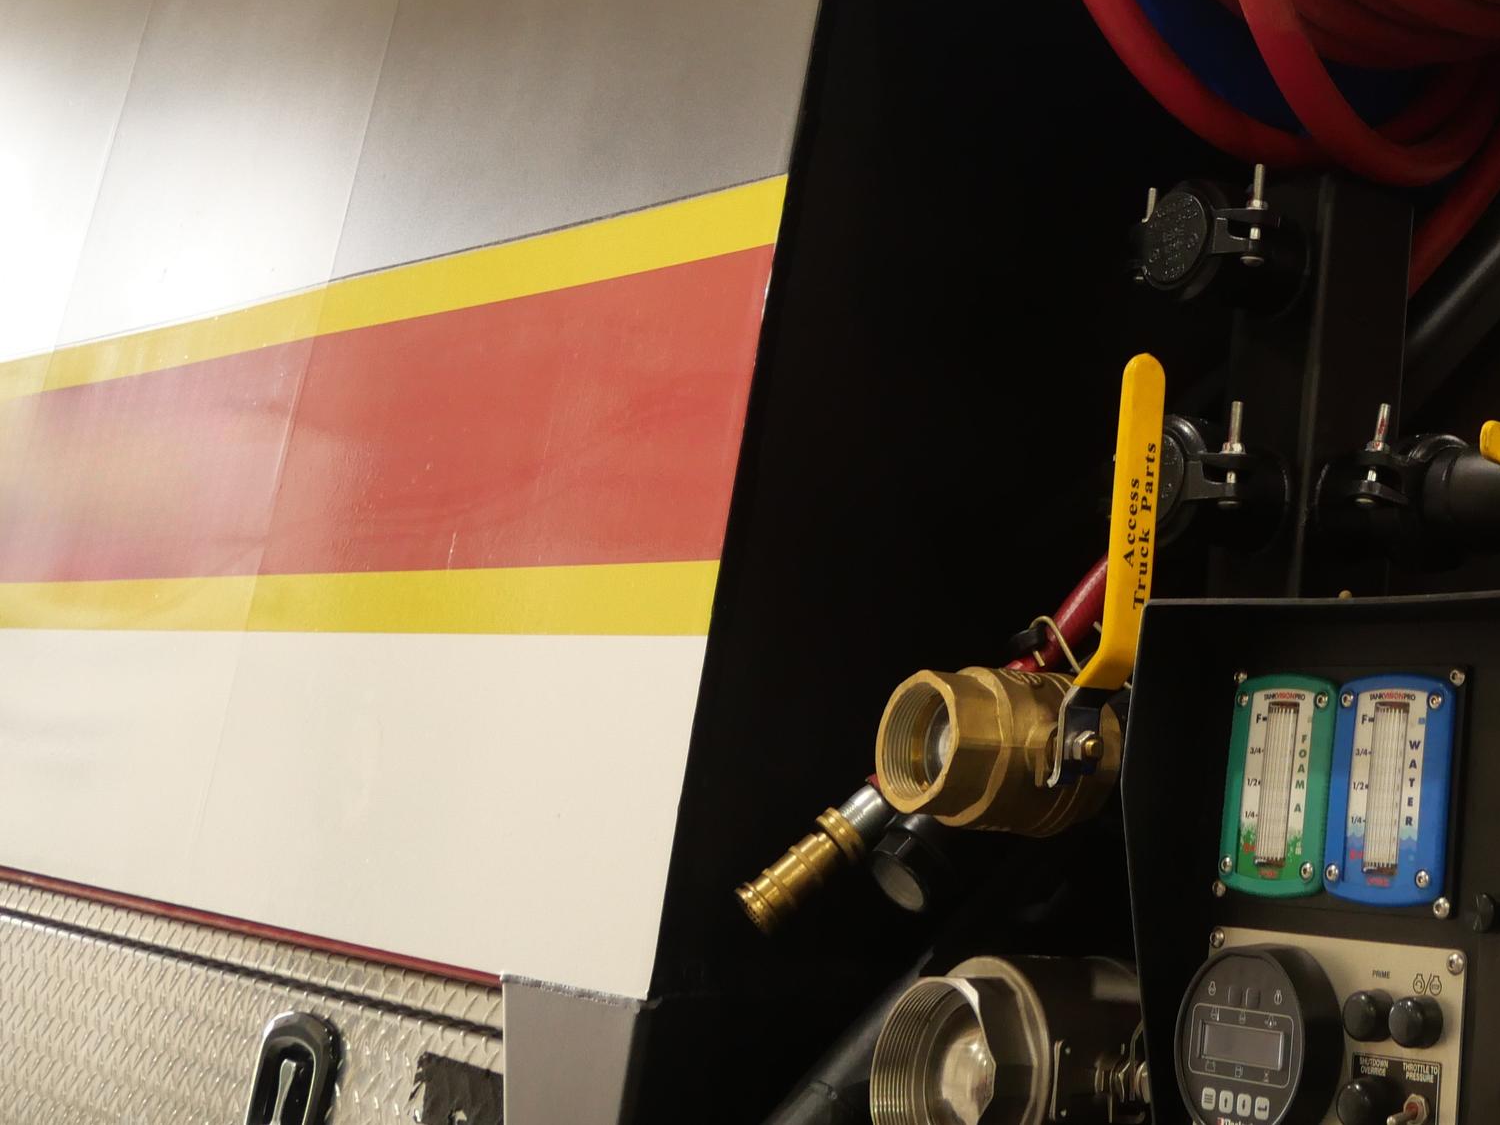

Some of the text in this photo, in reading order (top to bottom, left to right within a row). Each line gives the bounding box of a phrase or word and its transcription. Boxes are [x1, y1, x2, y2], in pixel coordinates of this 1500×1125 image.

[1123, 477, 1140, 567] Access
[1133, 442, 1157, 610] Truck Parts
[1405, 740, 1421, 826] WATER
[1372, 969, 1391, 979] PRIME
[1360, 1057, 1389, 1068] SHUTDOWN
[1403, 1062, 1430, 1073] THROTTLE
[1405, 1071, 1435, 1083] PRESSURE
